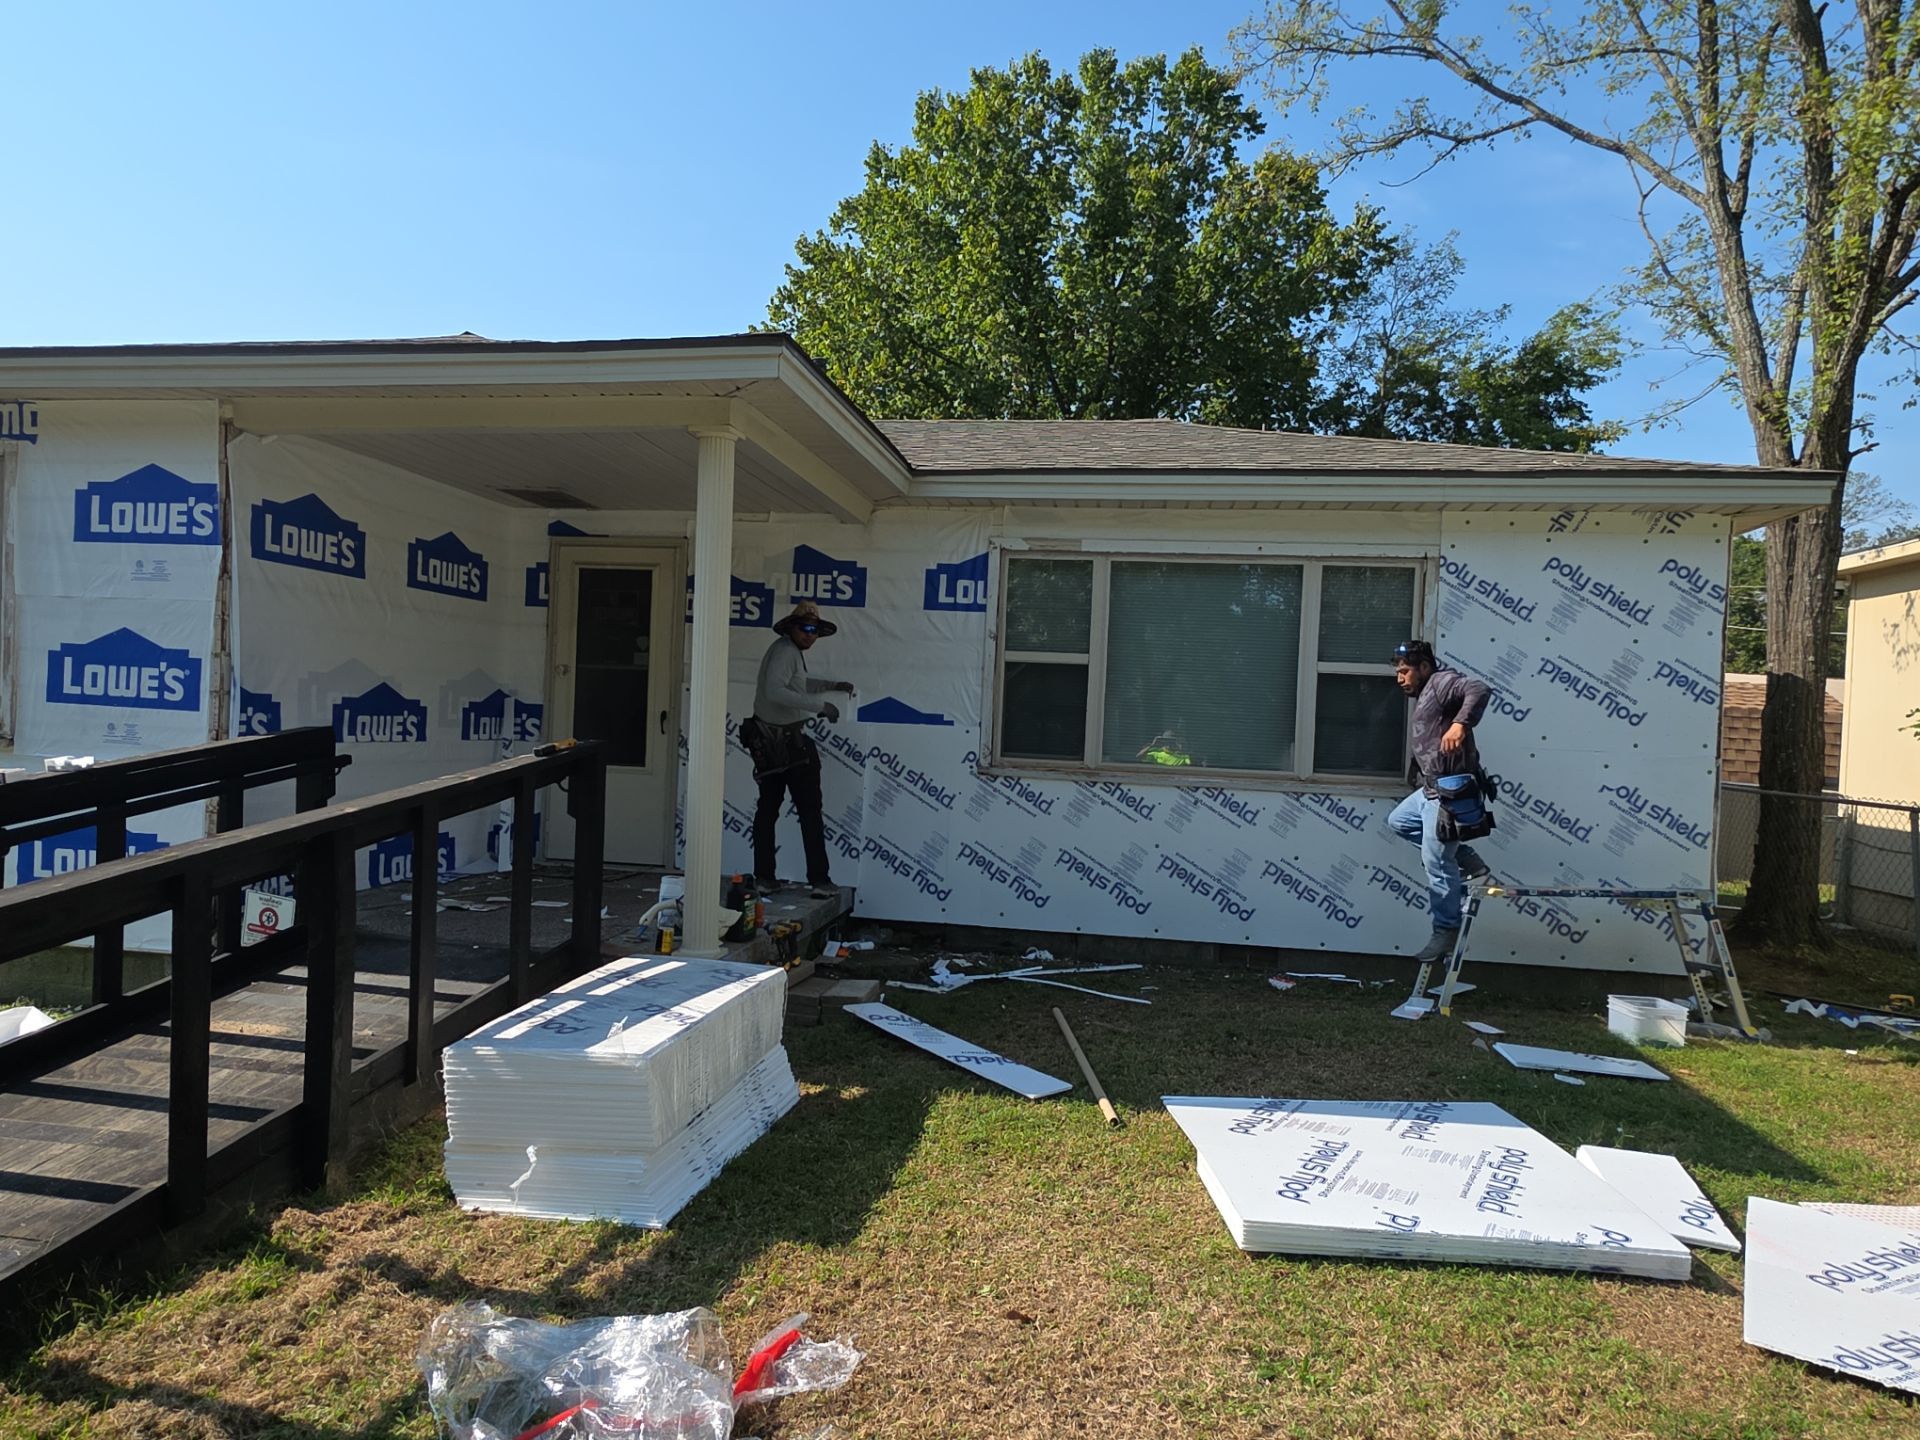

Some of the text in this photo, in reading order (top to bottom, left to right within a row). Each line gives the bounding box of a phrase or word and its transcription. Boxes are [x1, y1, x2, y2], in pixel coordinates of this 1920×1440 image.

[90, 494, 214, 536] LOWE'S
[264, 513, 356, 570] LOWE'S
[416, 550, 481, 594] LOWE'S
[1541, 556, 1593, 591] poly
[1657, 558, 1710, 594] poly
[62, 656, 185, 702] LOWE'S
[341, 709, 419, 743] LOWE'S
[1598, 691, 1649, 727] poly
[867, 746, 906, 779] poly
[911, 868, 953, 902] poly
[1008, 874, 1051, 909] poly
[1108, 879, 1152, 916] poly
[1211, 887, 1257, 923] poly
[1316, 900, 1365, 930] poly
[1539, 906, 1590, 945] poly
[1486, 1144, 1535, 1175] poly
[1276, 1170, 1328, 1205] poly
[1806, 1262, 1890, 1294] poly
